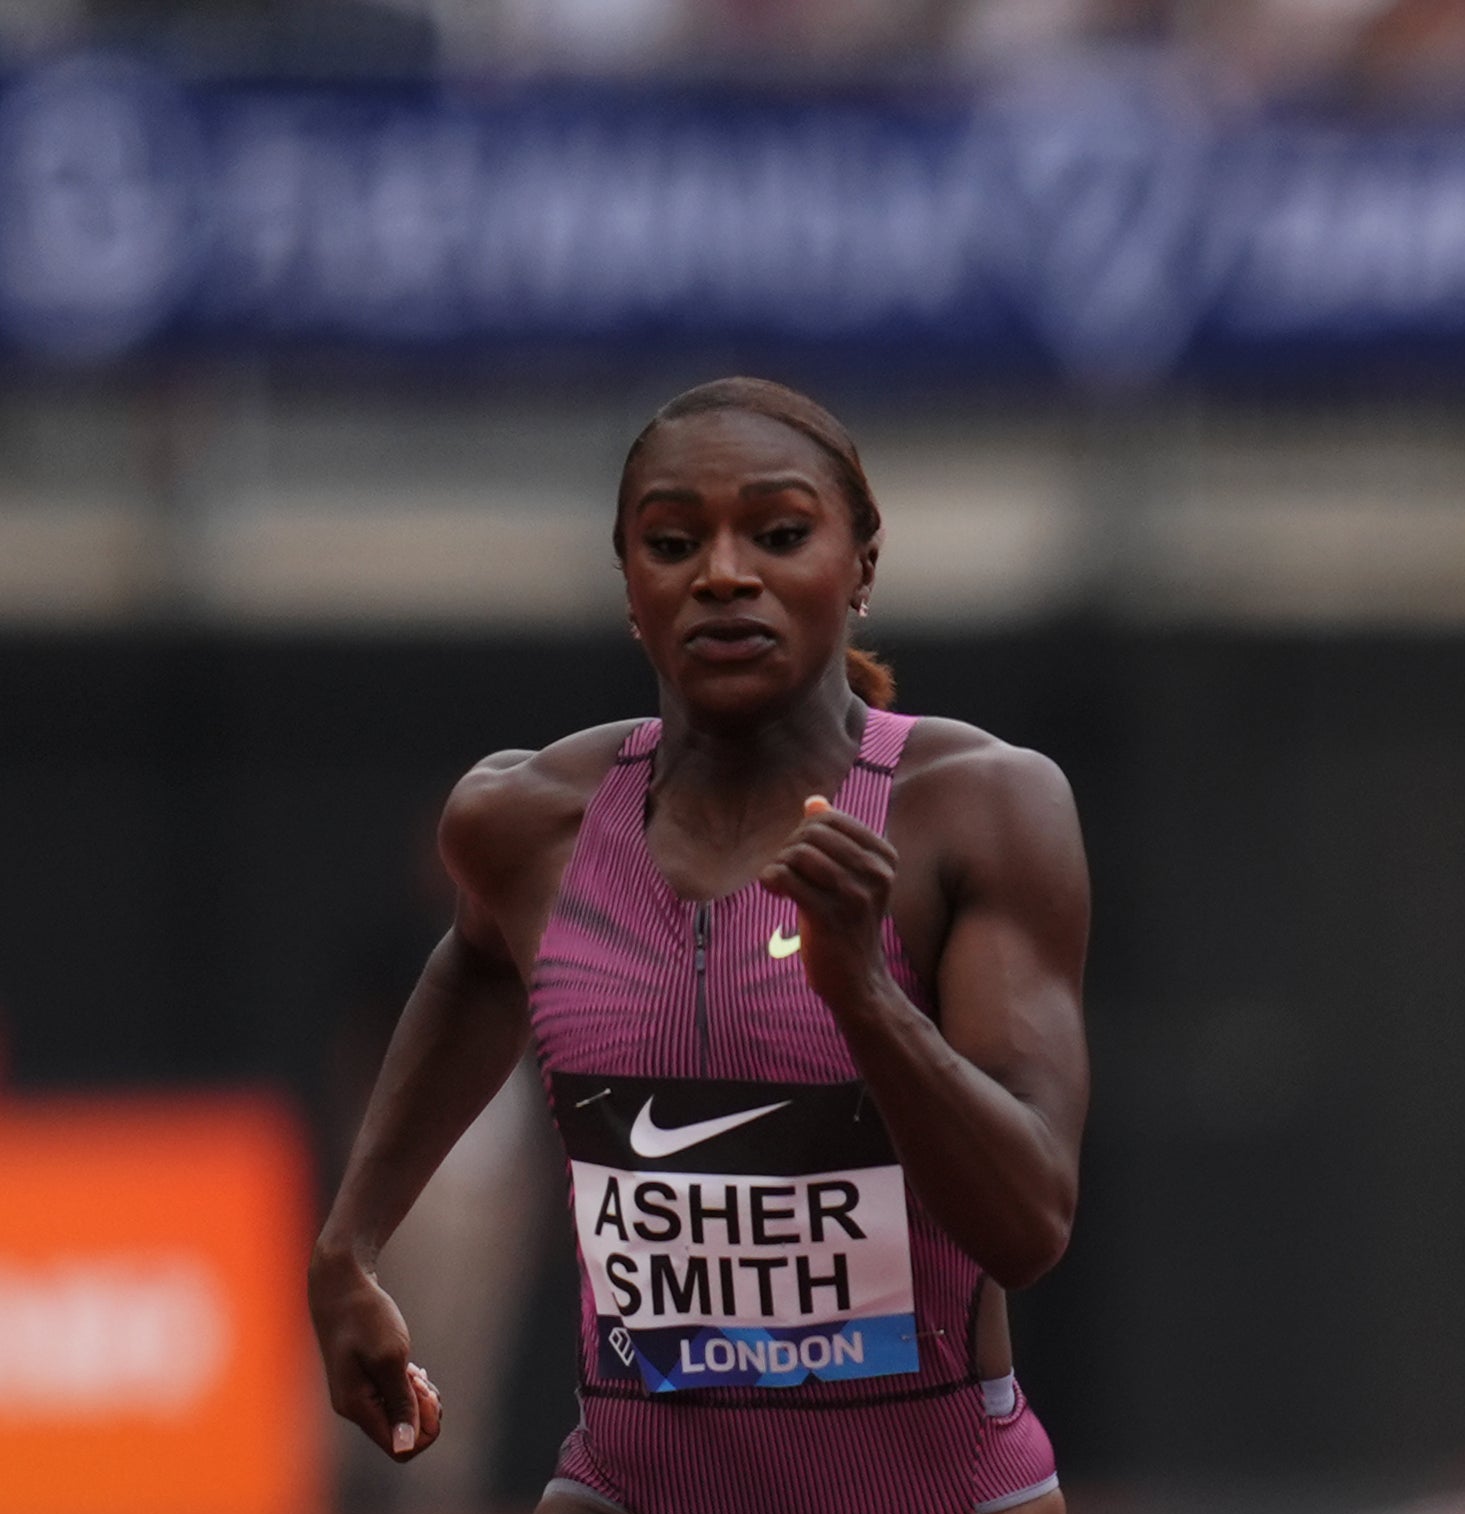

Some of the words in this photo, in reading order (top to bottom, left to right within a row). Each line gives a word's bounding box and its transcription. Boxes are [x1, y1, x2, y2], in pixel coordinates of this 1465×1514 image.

[595, 1176, 867, 1246] ASHER
[605, 1252, 852, 1318] SMITH
[680, 1330, 865, 1374] LONDON
